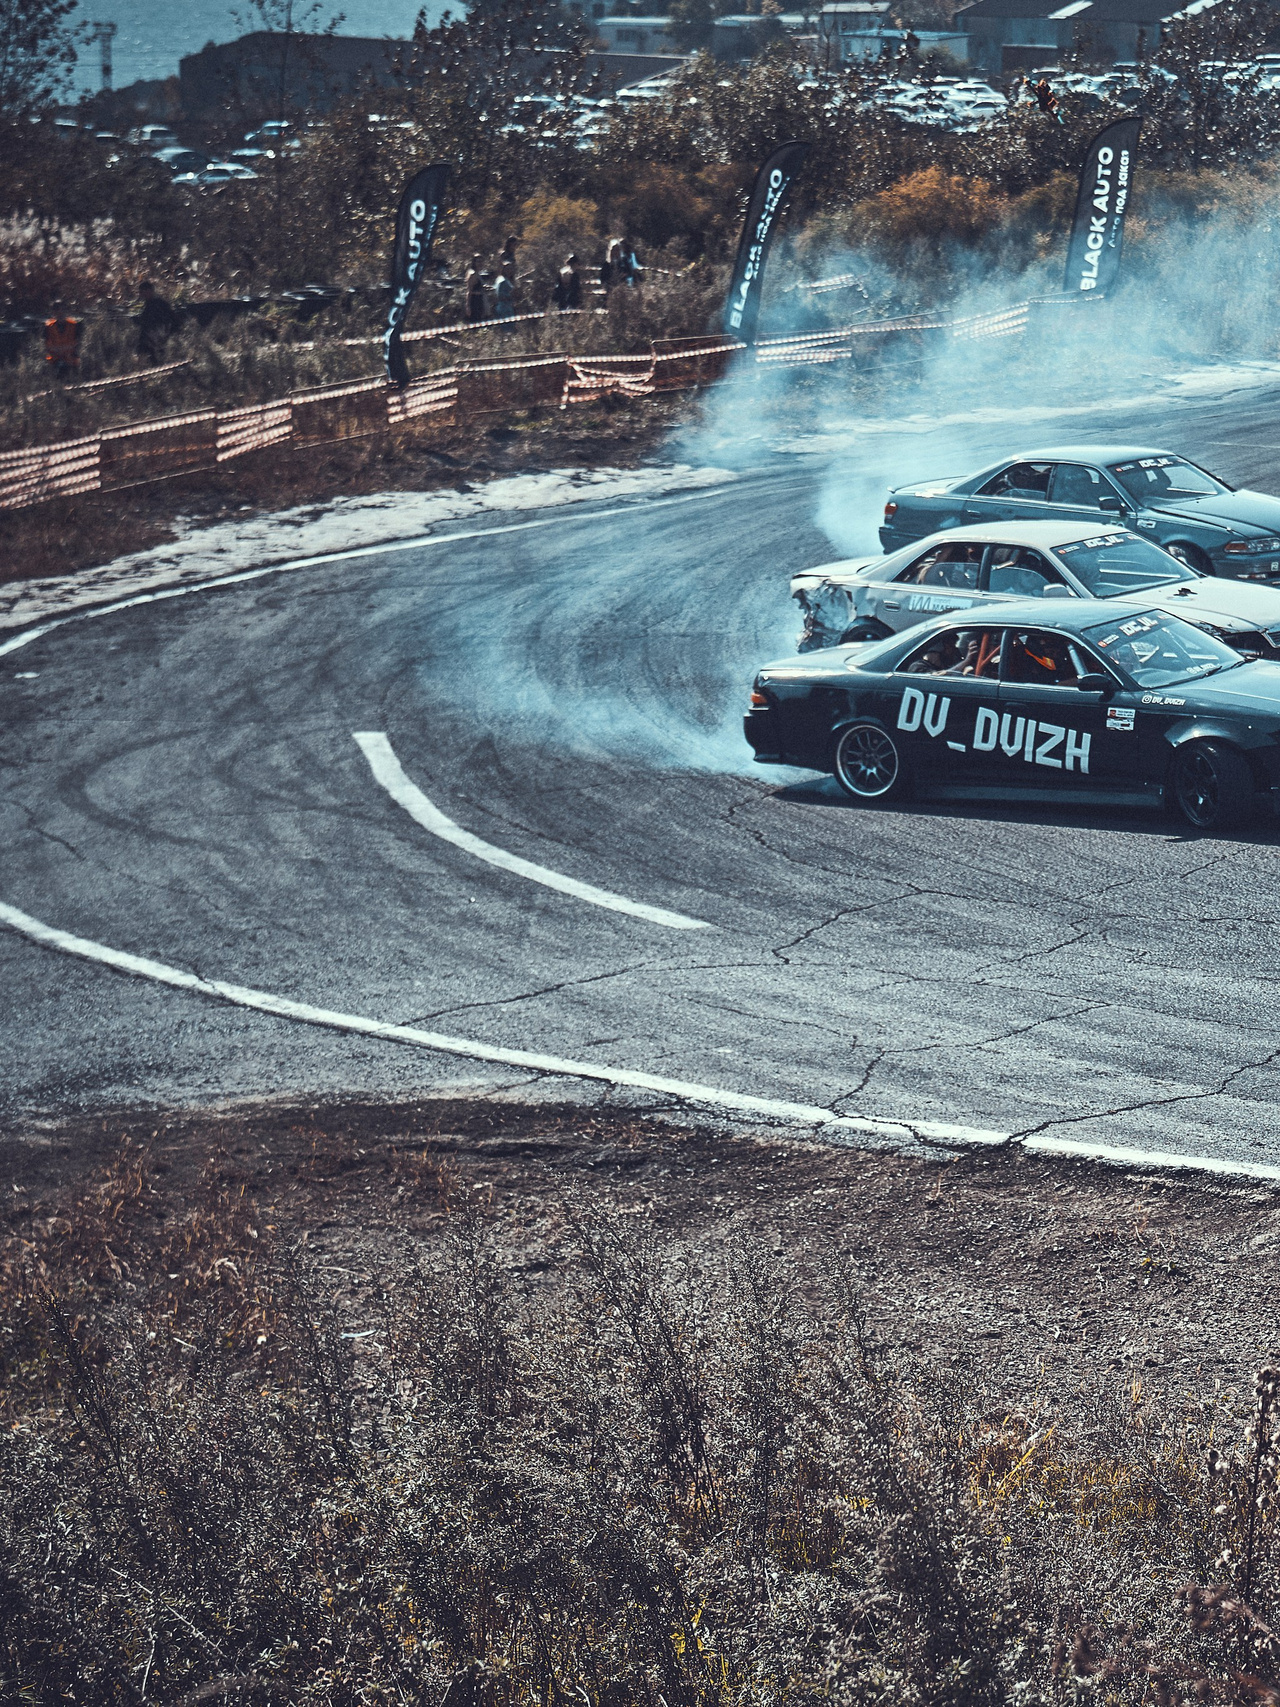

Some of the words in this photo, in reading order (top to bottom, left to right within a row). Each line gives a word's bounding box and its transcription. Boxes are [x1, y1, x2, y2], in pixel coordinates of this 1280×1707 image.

[1093, 146, 1114, 213] AUTO
[1116, 189, 1128, 214] под
[407, 199, 426, 282] AUTO
[1080, 216, 1107, 291] BLACK
